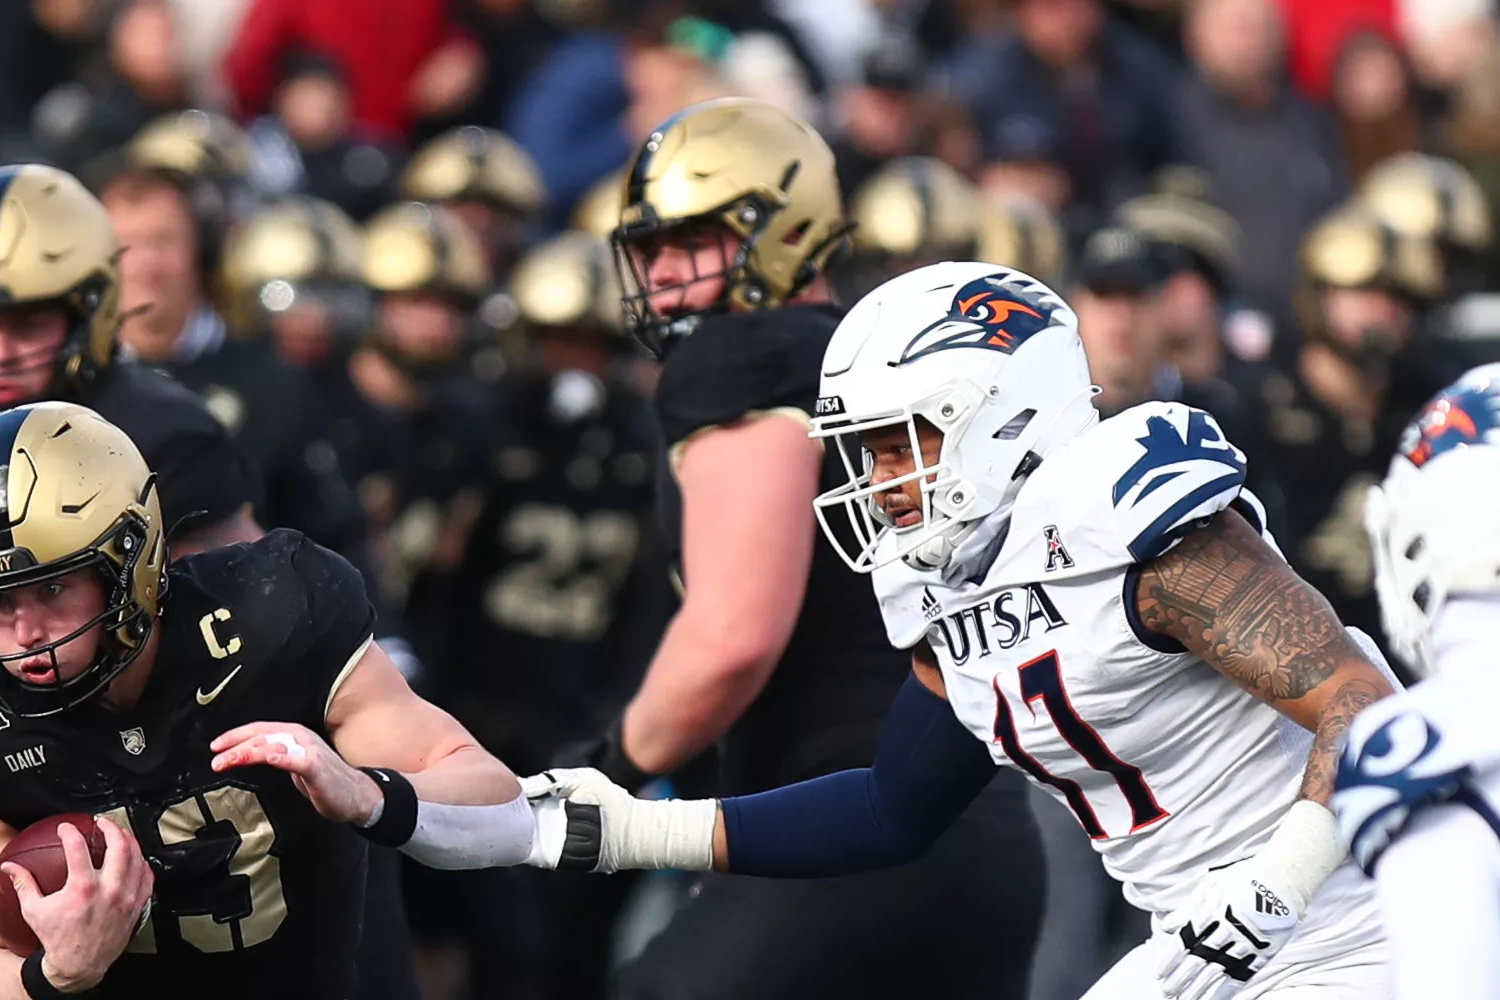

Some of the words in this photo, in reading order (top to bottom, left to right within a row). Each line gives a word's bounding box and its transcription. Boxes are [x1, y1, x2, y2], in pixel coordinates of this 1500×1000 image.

[199, 607, 242, 659] C
[937, 582, 1069, 667] UTSA
[4, 745, 47, 773] DAILY
[1251, 879, 1290, 916] adidas
